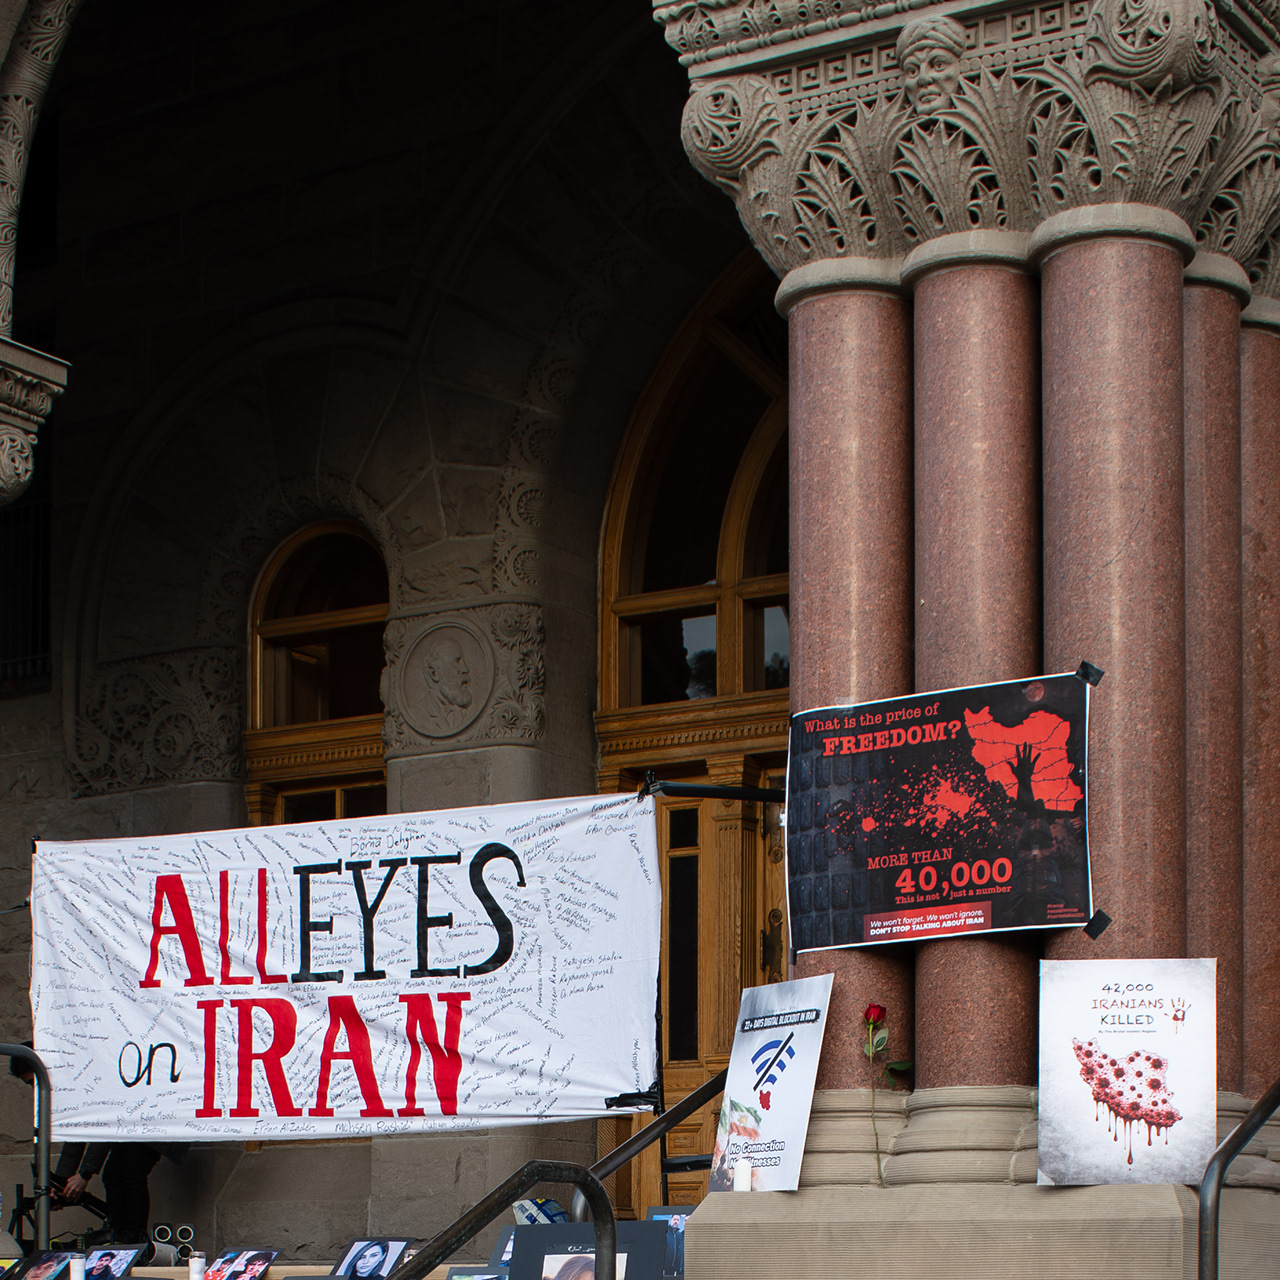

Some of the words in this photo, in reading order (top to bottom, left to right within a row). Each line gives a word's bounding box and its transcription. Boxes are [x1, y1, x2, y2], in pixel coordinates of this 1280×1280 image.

[805, 716, 841, 734] What
[844, 715, 857, 729] is
[860, 712, 882, 726] the
[885, 706, 922, 726] price
[925, 702, 941, 718] of
[822, 719, 962, 757] FREEDOM?
[867, 853, 909, 870] MORE
[911, 847, 954, 865] THAN
[895, 857, 1013, 897] 40,000
[895, 895, 915, 904] This
[916, 894, 924, 903] is
[925, 892, 940, 901] not
[949, 890, 967, 900] just
[975, 885, 1013, 895] number
[139, 867, 289, 988] ALL
[291, 842, 527, 984] EYES
[870, 920, 882, 928] We
[882, 917, 902, 928] won't
[902, 915, 925, 926] forget.
[926, 913, 939, 922] We
[939, 911, 958, 921] won't
[959, 909, 984, 919] ignore.
[869, 926, 891, 936] DON'T
[891, 925, 911, 934] STOP
[911, 922, 941, 932] TALKING
[941, 919, 966, 929] ABOUT
[966, 916, 985, 926] IRAN
[1101, 982, 1154, 996] 42,000
[1091, 998, 1164, 1010] IRANIANS
[1100, 1014, 1155, 1025] KILLED
[118, 1041, 184, 1088] on
[195, 991, 471, 1118] IRAN
[730, 1143, 741, 1155] No
[742, 1140, 786, 1154] Connection
